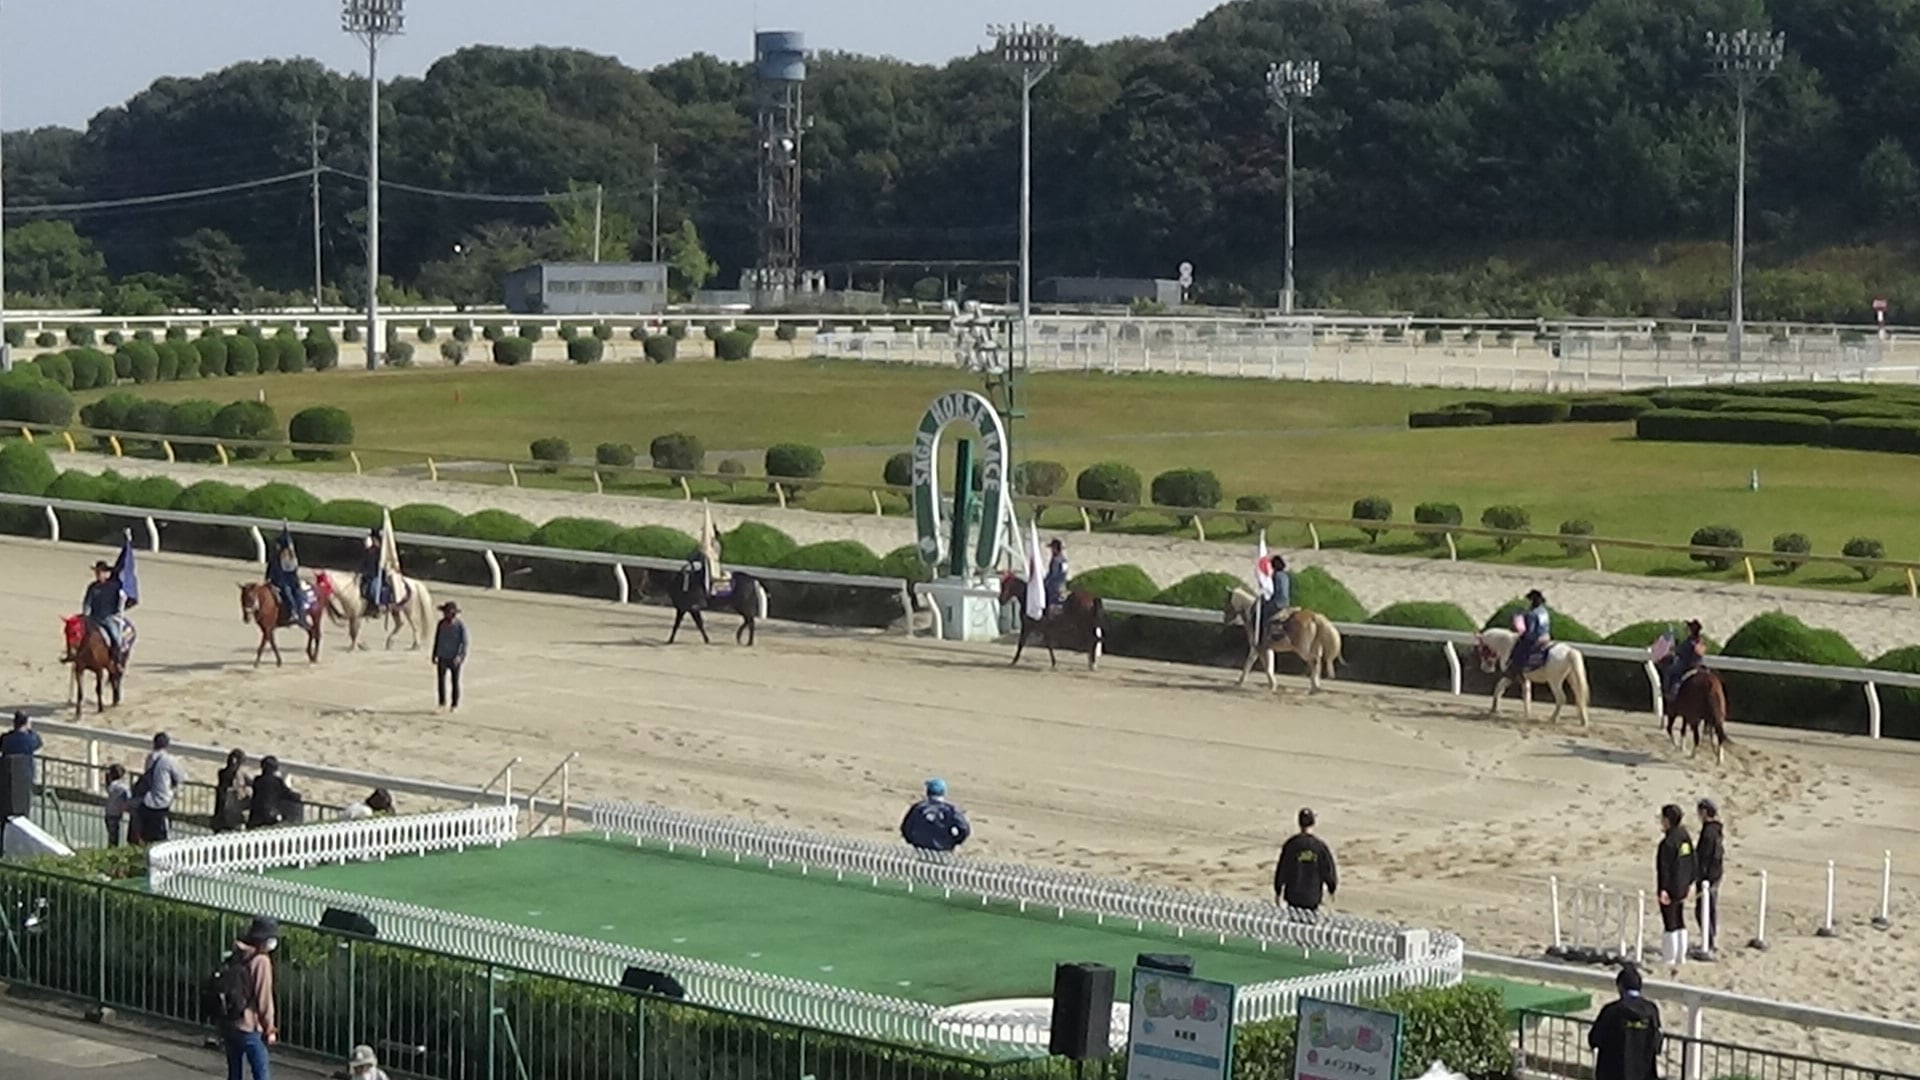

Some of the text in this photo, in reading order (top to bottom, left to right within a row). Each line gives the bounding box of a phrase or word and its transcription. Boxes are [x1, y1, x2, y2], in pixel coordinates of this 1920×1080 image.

[915, 394, 1001, 491] SAGA HORSE RACE
